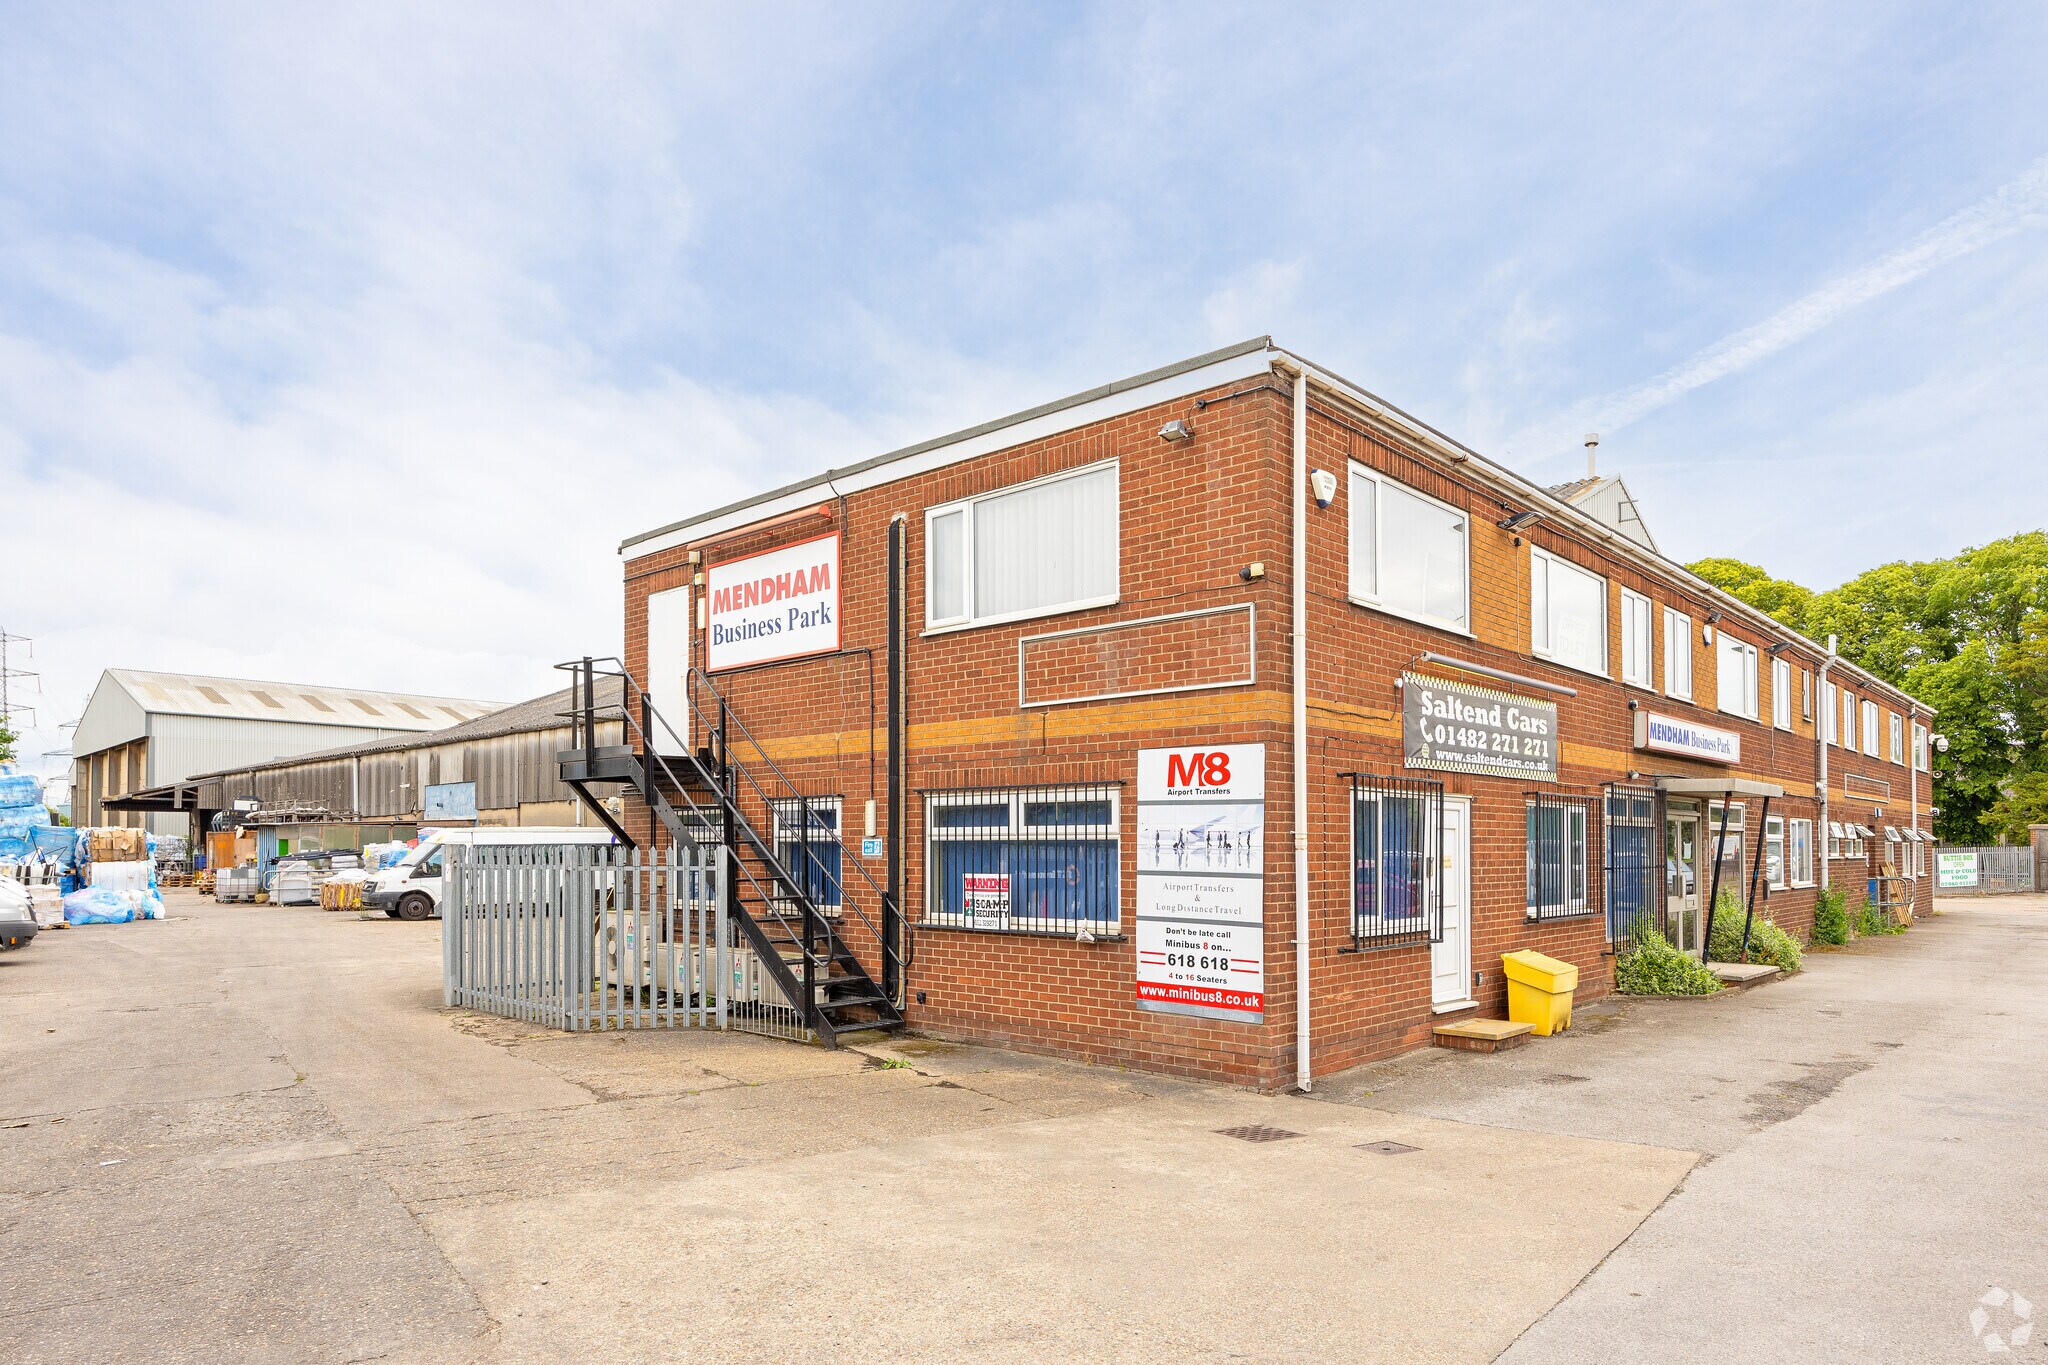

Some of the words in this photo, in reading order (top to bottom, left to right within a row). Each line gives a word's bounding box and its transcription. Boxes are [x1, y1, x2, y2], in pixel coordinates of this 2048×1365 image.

[713, 562, 831, 615] MENDHAM
[712, 616, 782, 646] Business
[787, 602, 832, 631] Park
[1421, 690, 1502, 728] Saltend
[1507, 707, 1548, 734] Cars
[1434, 724, 1487, 750] 01482
[1492, 733, 1519, 754] 271
[1524, 738, 1549, 758] 271
[1650, 722, 1690, 746] MENDHAM
[1692, 731, 1716, 752] Business
[1717, 737, 1730, 754] Park
[1436, 750, 1549, 771] www.saltendcars.co.uk
[1167, 752, 1232, 788] M8
[1167, 788, 1193, 796] Airport
[965, 878, 1008, 888] WARNING
[1163, 883, 1192, 892] Airport
[1194, 884, 1234, 892] Transfers
[976, 910, 1008, 918] SECURITY
[1156, 903, 1176, 913] Long
[1178, 904, 1213, 913] Distance
[1215, 906, 1241, 914] Travel
[1166, 927, 1186, 936] Don't
[1188, 928, 1197, 936] be
[1199, 929, 1214, 937] late
[1166, 940, 1200, 950] Minibus
[1211, 944, 1232, 952] on...
[1168, 954, 1195, 968] 618
[1200, 956, 1229, 971] 618
[1196, 975, 1227, 984] Seaters
[1140, 986, 1259, 1008] www.minibus8.co.uk
